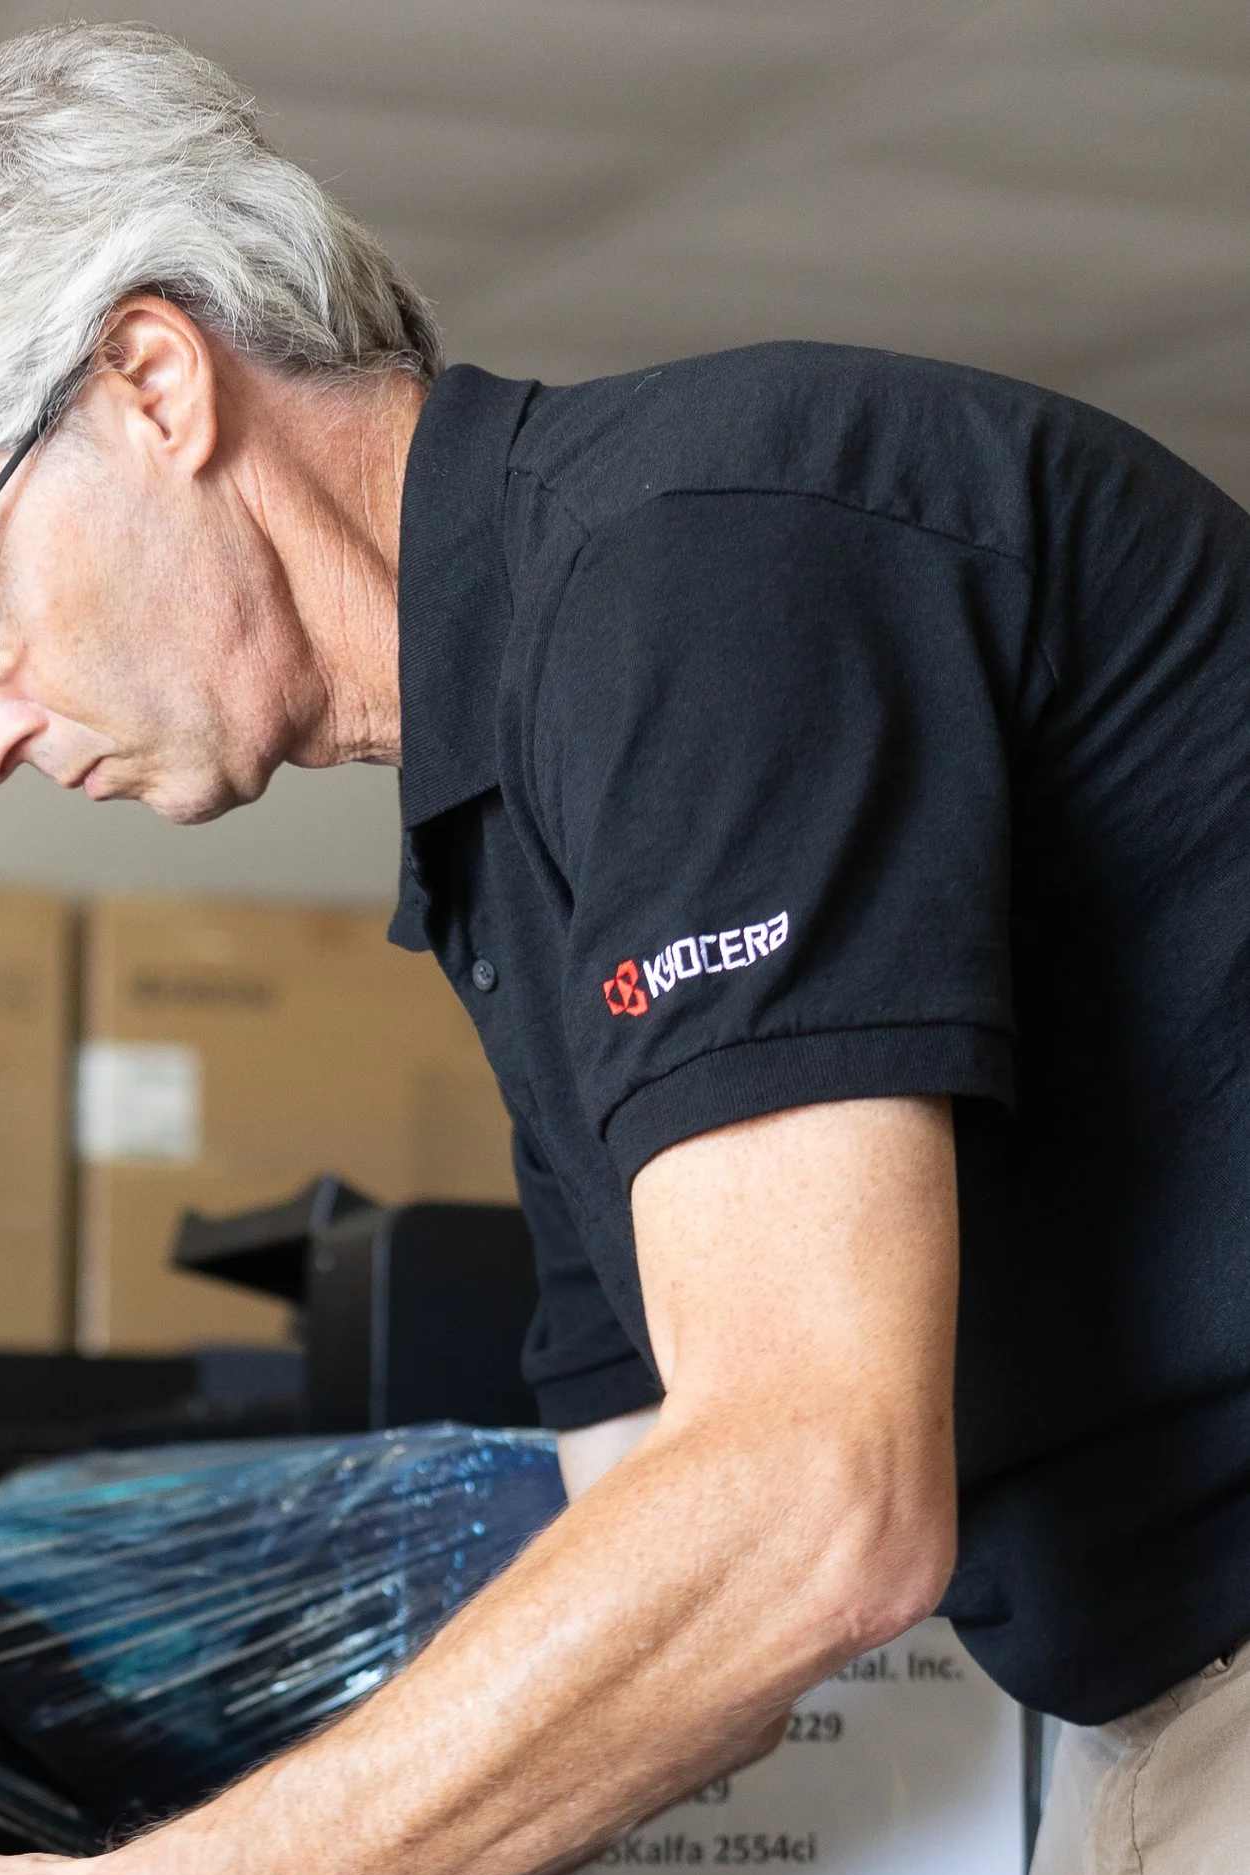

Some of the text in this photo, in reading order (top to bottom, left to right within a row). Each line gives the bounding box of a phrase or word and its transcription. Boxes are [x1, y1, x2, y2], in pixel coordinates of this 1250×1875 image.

[642, 910, 789, 999] KYOCERA
[907, 1652, 964, 1683] Inc.
[714, 1832, 819, 1865] 2554ci
